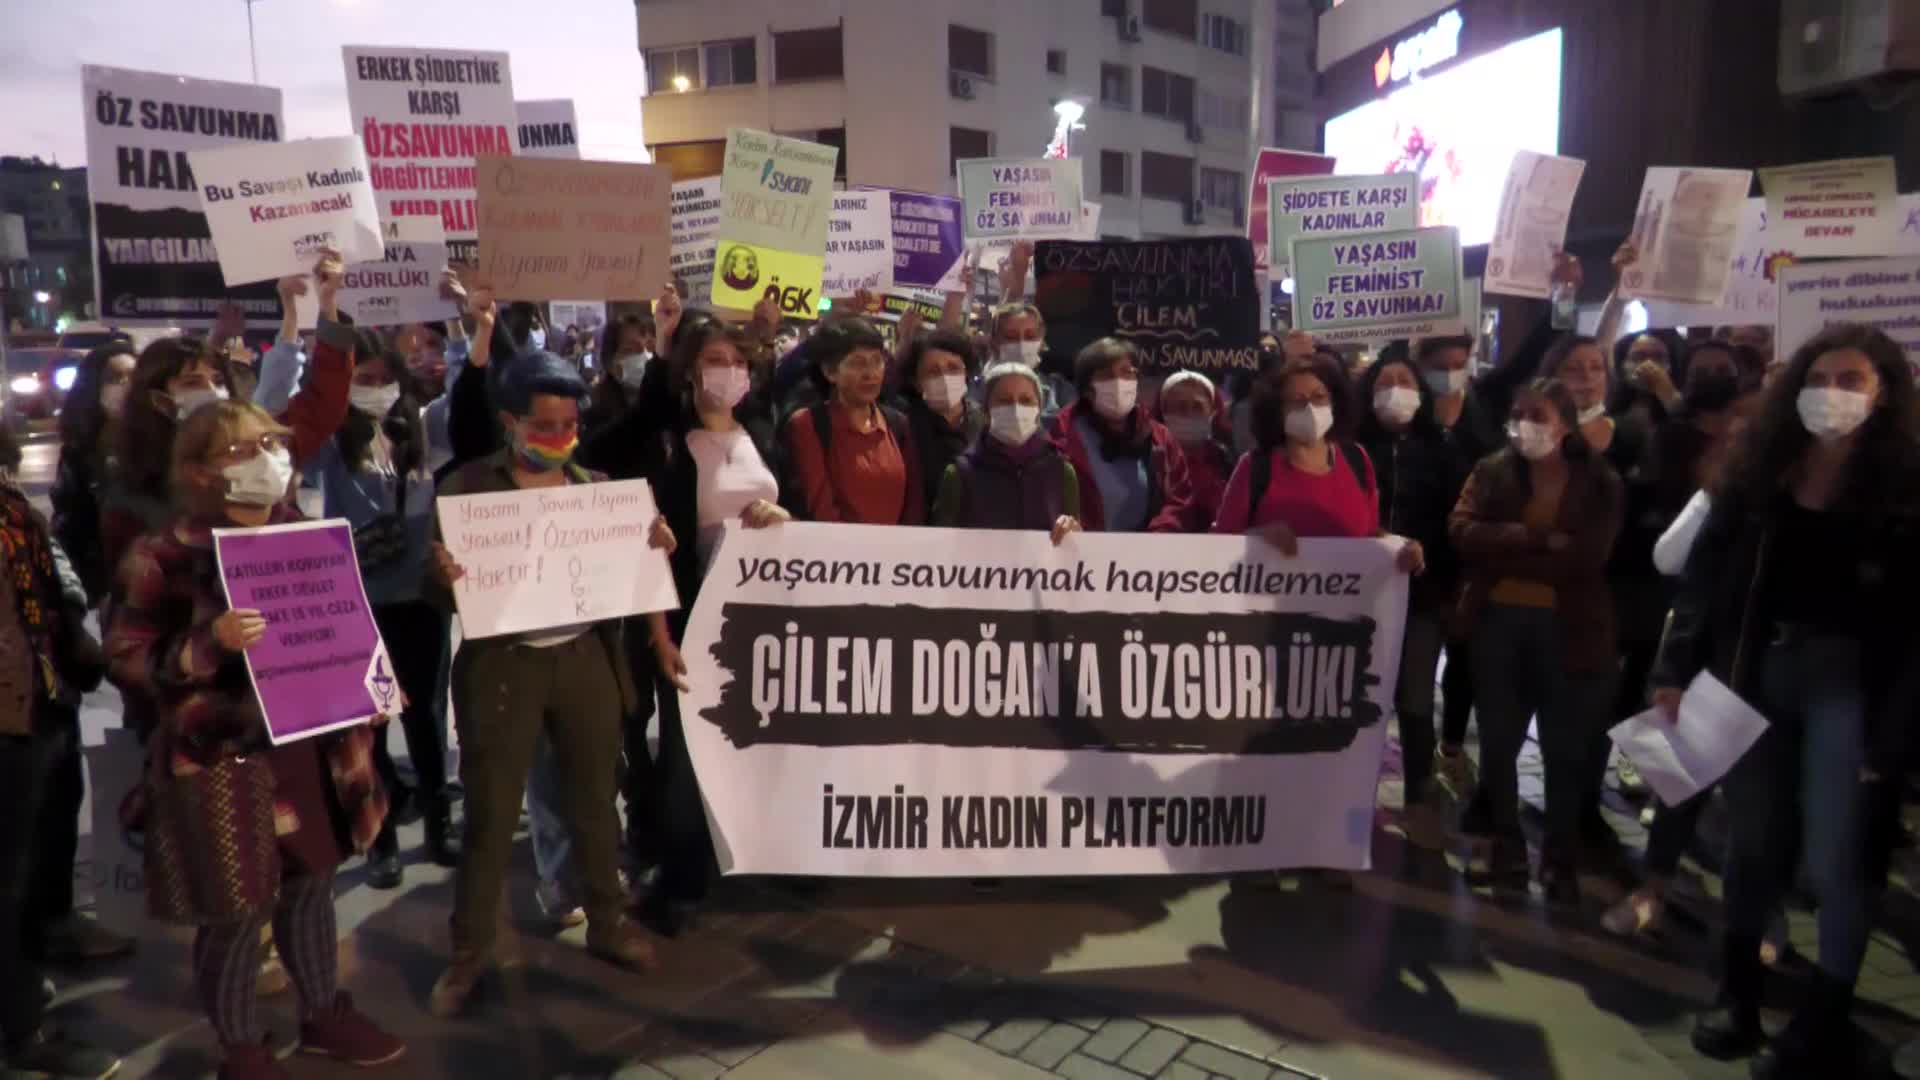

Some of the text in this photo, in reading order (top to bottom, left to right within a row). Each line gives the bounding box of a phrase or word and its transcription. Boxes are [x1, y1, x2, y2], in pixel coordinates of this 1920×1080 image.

[356, 54, 501, 88] ERKEK ŞİDDETİNE
[96, 90, 280, 142] ÖZ SAVUNMA
[408, 89, 461, 120] KARŞI
[363, 116, 513, 158] ÖZSAVUNMA
[205, 185, 234, 202] Bu
[249, 193, 353, 223] Kazanacak!
[1283, 187, 1408, 213] ŞİDDETE KARŞI
[977, 210, 996, 228] ÖZ
[1302, 211, 1385, 232] KADINLAR
[1334, 240, 1417, 265] YAŞASIN
[1328, 266, 1424, 294] FEMİNİST
[1313, 296, 1335, 320] ÖZ
[735, 555, 1361, 602] yaşamı savunmak hapsedilemez
[752, 621, 1355, 728] ÇİLEM DOĞAN'A ÖZGÜRLÜK!
[822, 783, 1266, 849] İZMİR KADIN PLATFORMU
